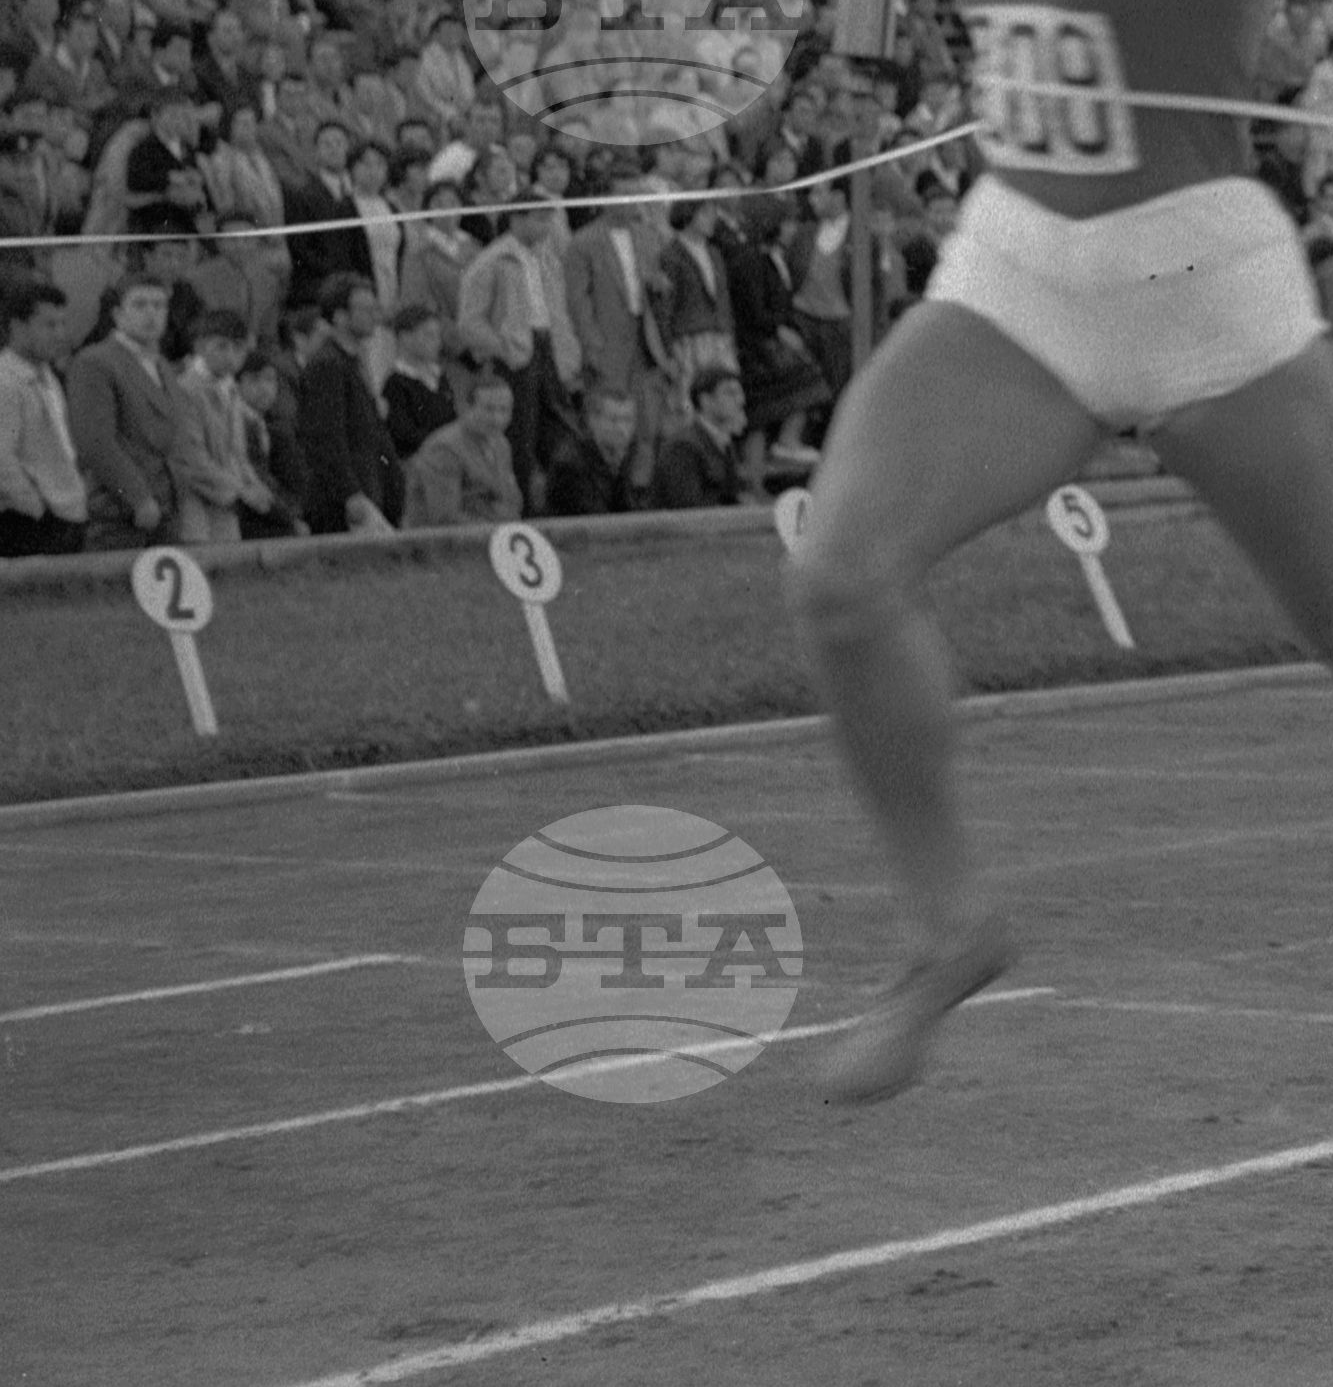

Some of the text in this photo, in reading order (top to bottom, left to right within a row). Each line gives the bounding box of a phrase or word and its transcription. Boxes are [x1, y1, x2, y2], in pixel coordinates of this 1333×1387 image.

[1062, 493, 1094, 538] 5
[155, 556, 195, 620] 2
[510, 532, 543, 588] 3
